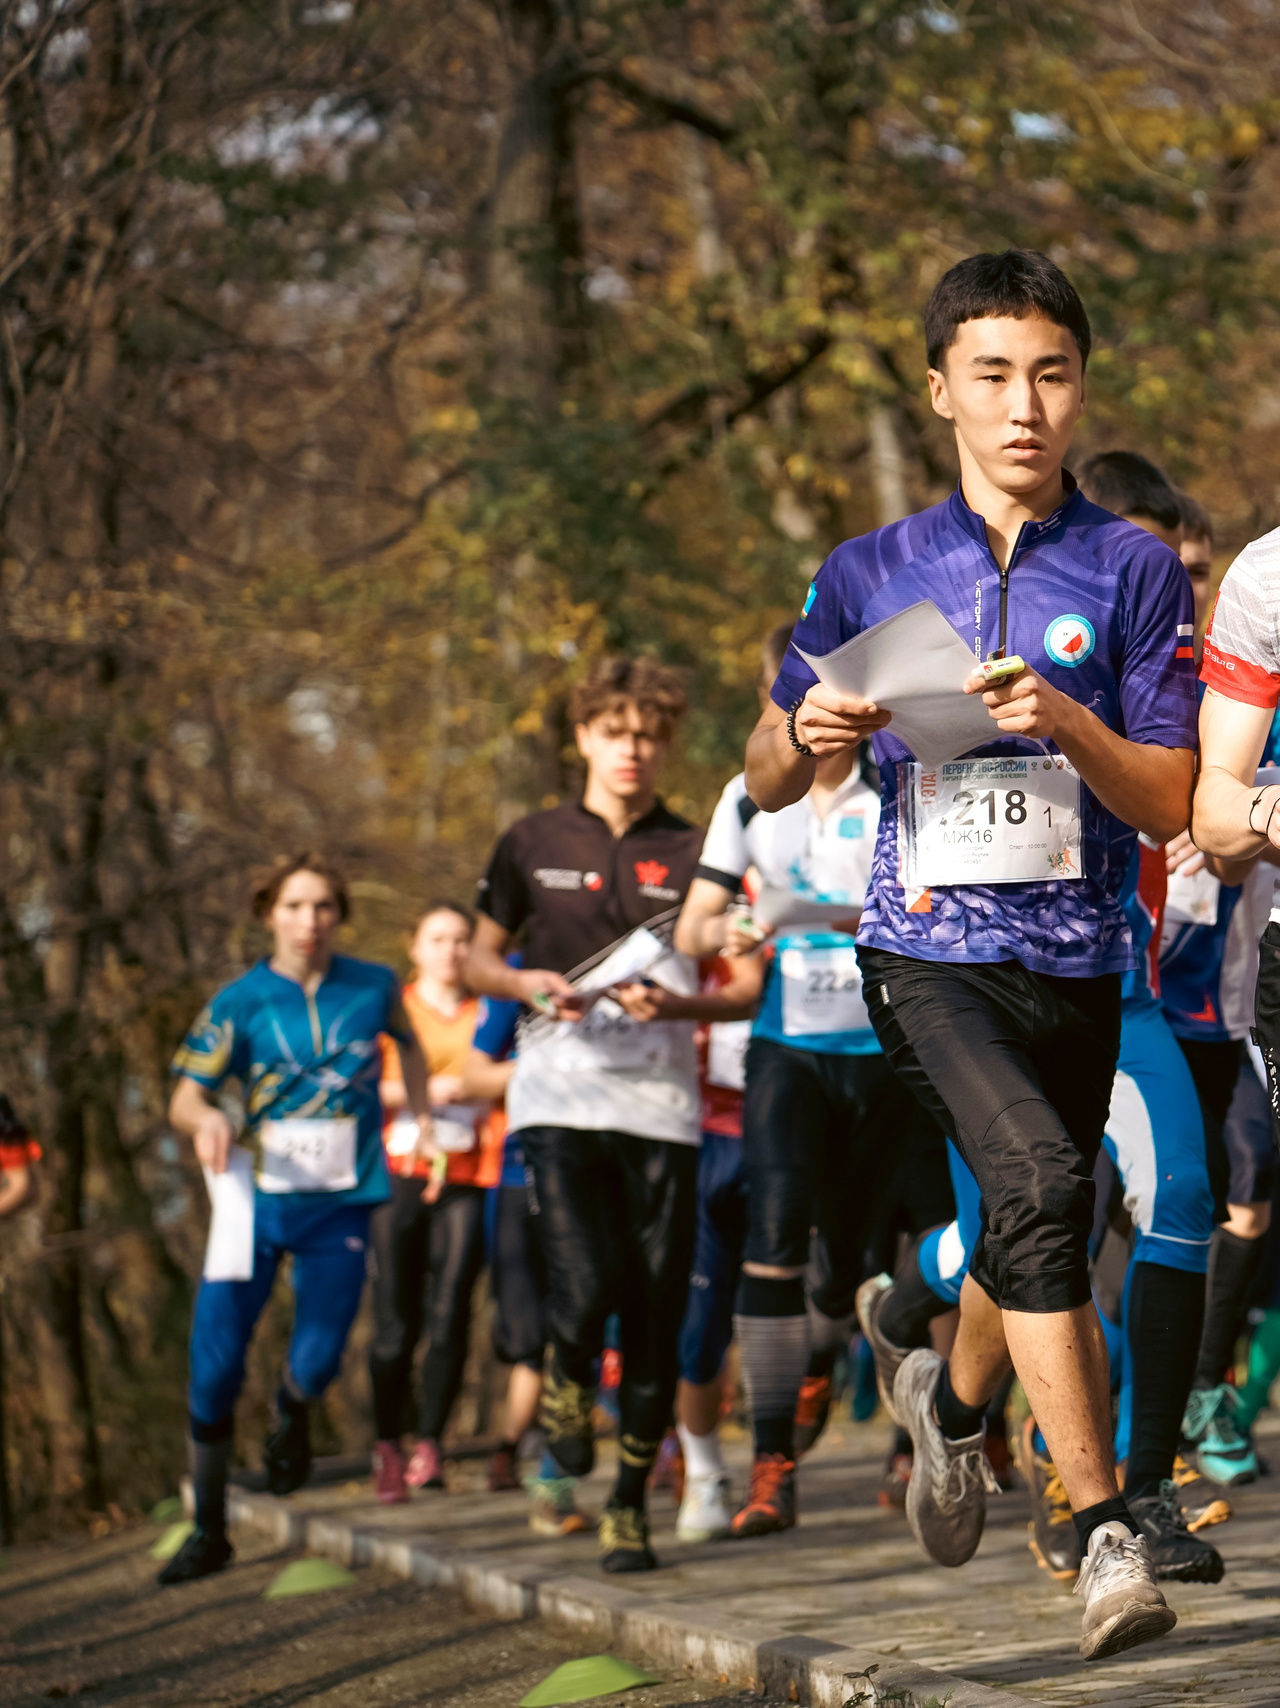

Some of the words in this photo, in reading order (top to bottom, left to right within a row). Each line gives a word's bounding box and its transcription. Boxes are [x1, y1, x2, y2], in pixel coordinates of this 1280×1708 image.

[942, 762, 994, 775] ПЕРВЕНСТВО
[994, 760, 1027, 773] РОССИИ
[952, 789, 1028, 826] 218
[1043, 806, 1052, 828] 1
[943, 829, 993, 844] МЖ16
